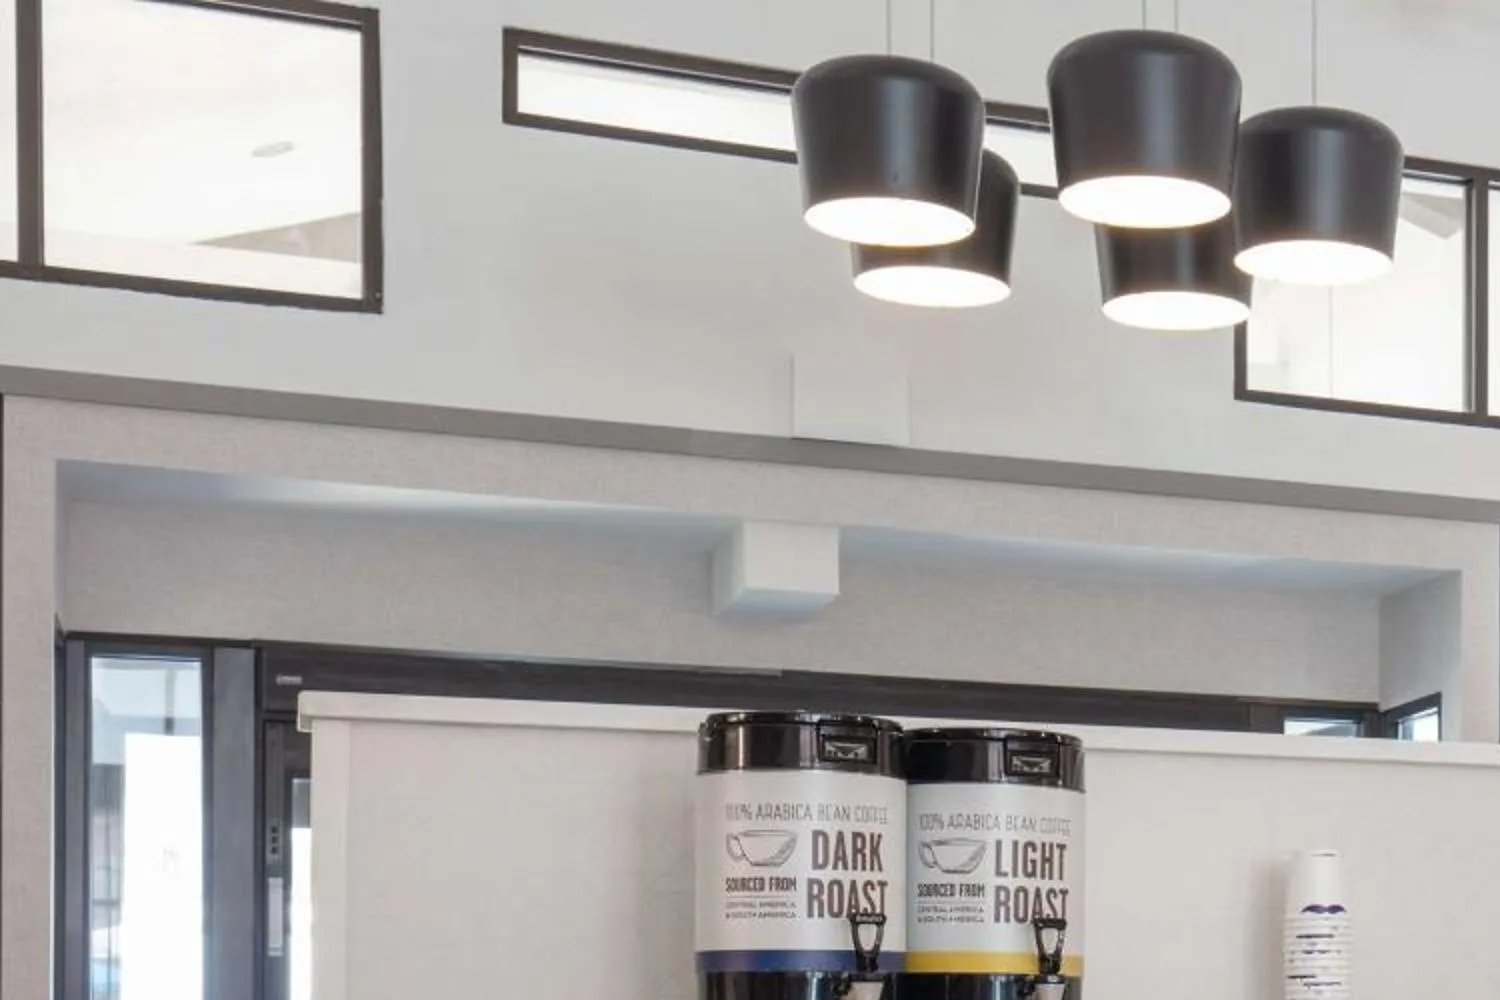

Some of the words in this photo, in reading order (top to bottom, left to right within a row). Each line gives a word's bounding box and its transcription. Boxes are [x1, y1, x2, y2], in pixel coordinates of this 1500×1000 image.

[811, 829, 883, 872] DARK
[994, 840, 1067, 881] LIGHT
[726, 877, 765, 892] SOURCED
[769, 877, 797, 892] FROM
[807, 878, 888, 919] ROAST
[959, 883, 985, 897] FROM
[994, 885, 1069, 924] ROAST
